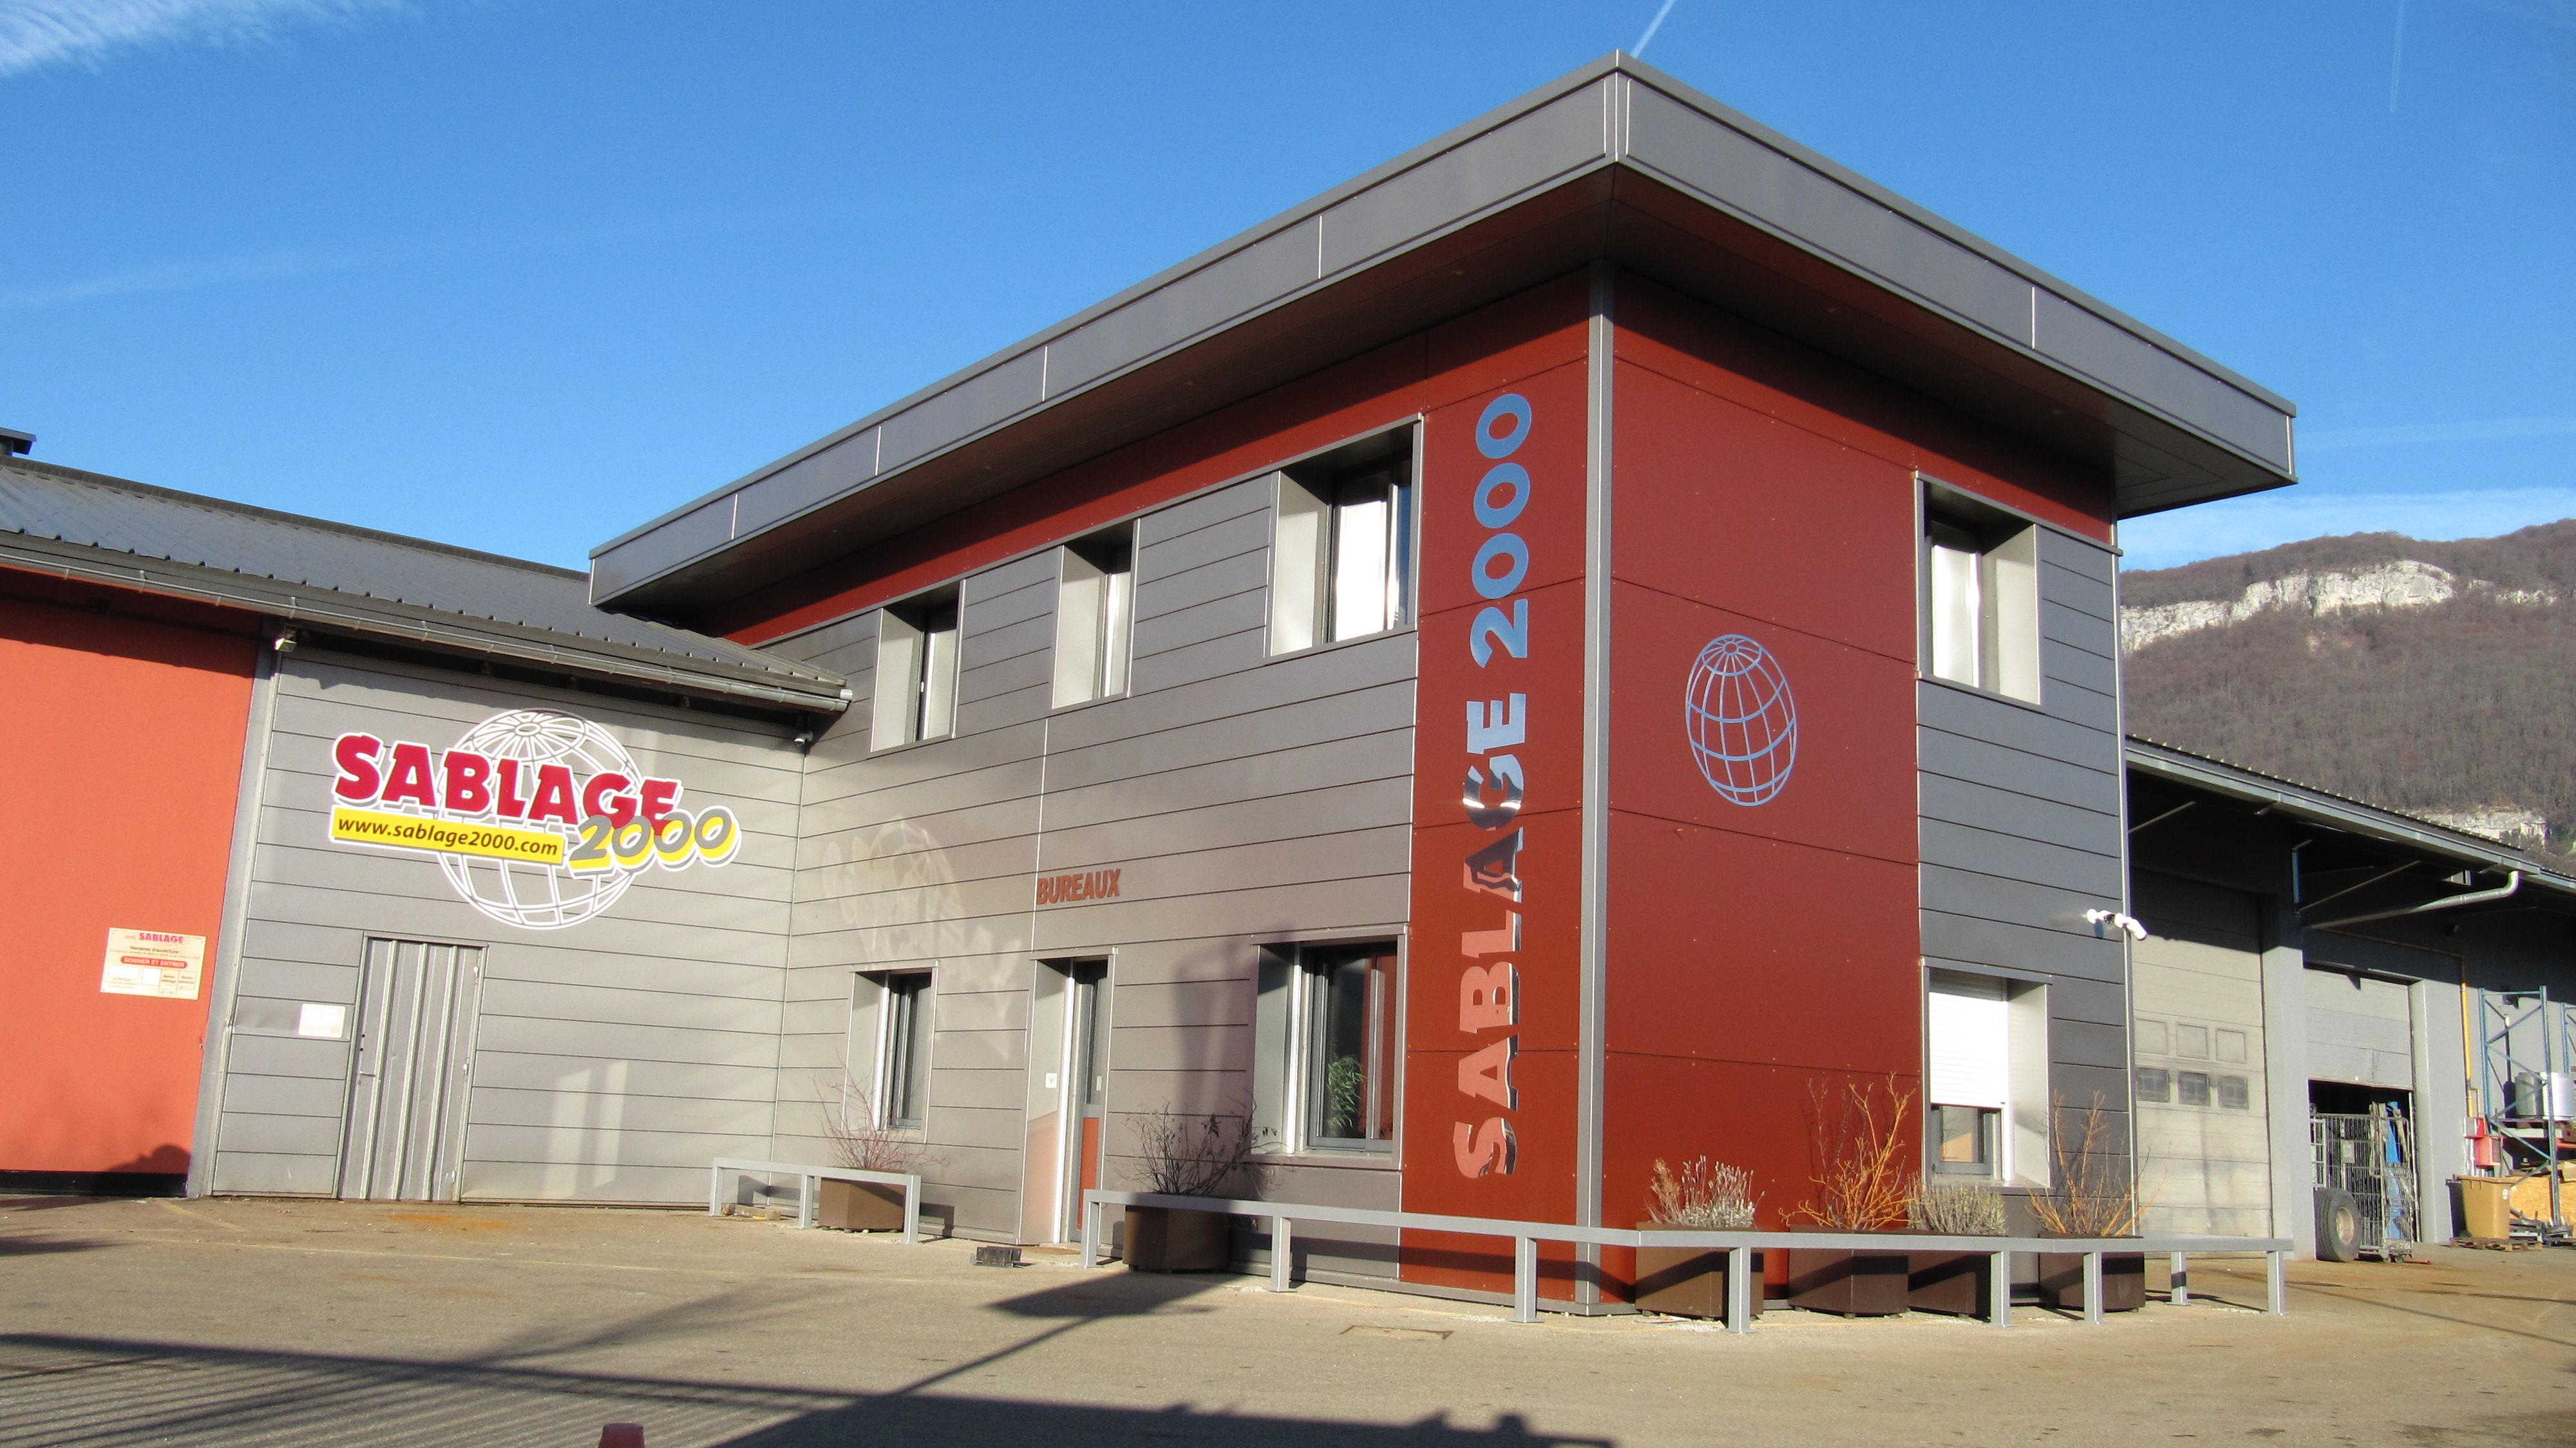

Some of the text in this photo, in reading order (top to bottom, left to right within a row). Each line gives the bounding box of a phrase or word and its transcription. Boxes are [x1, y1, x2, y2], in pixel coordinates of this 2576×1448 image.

[334, 733, 681, 837] SABLAGE
[1454, 393, 1532, 1179] SABLAGE 2000
[337, 817, 558, 856] www.sablage2000.com
[569, 808, 738, 871] 2000
[1036, 868, 1121, 904] BUREAUX
[139, 932, 184, 944] SABLAGE
[124, 957, 150, 965] SONNER
